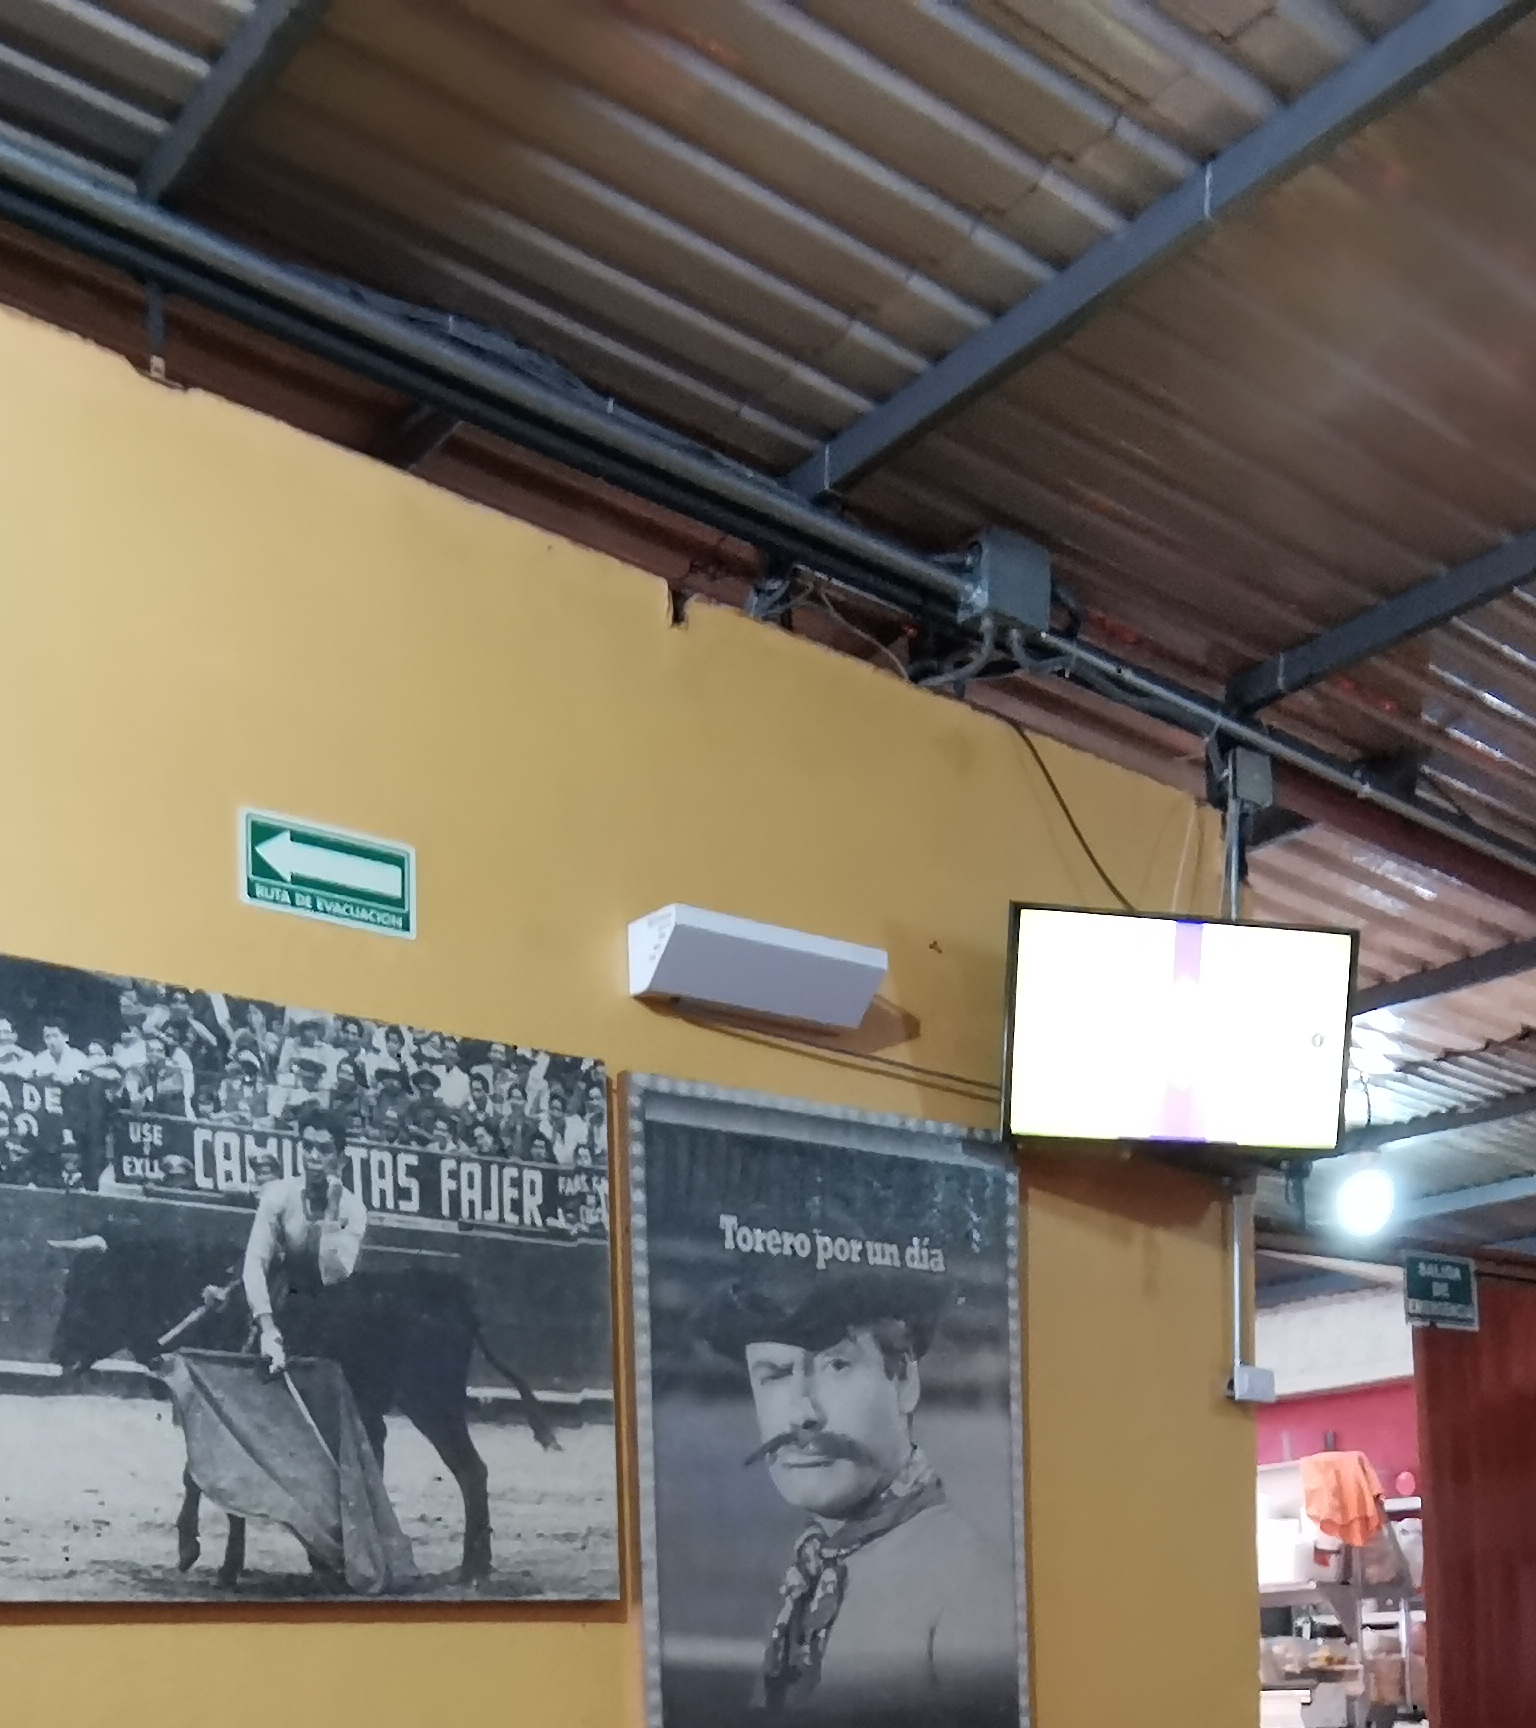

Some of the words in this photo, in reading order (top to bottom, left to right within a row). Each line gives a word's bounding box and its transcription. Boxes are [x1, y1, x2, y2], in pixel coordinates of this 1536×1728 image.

[255, 883, 291, 904] RUTA
[295, 893, 312, 909] DE
[22, 1083, 63, 1115] DE
[440, 1158, 543, 1227] FAJER
[719, 1213, 811, 1258] Torero
[813, 1228, 862, 1270] por
[866, 1240, 901, 1268] un
[905, 1236, 946, 1272] día
